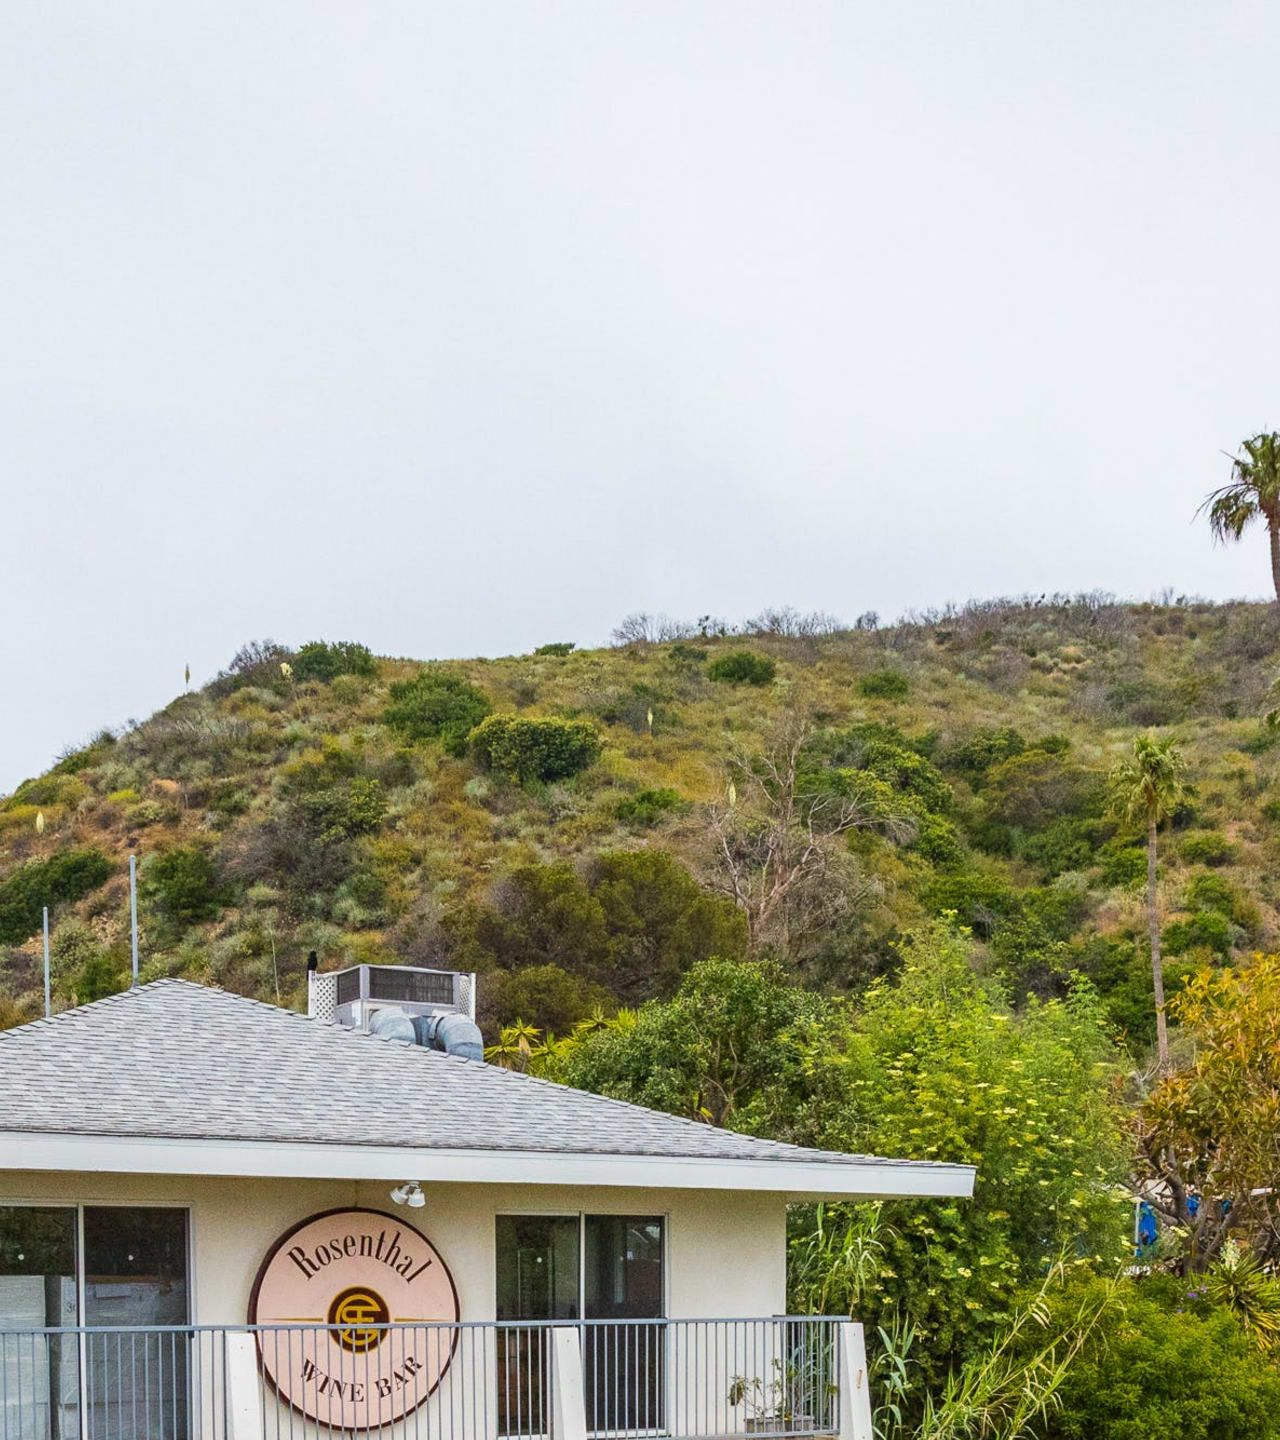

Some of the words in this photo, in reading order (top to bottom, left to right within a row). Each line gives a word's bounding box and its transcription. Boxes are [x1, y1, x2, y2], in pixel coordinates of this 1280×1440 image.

[286, 1230, 433, 1284] Rosenthal
[300, 1357, 365, 1402] WINE
[374, 1355, 424, 1399] BAR
